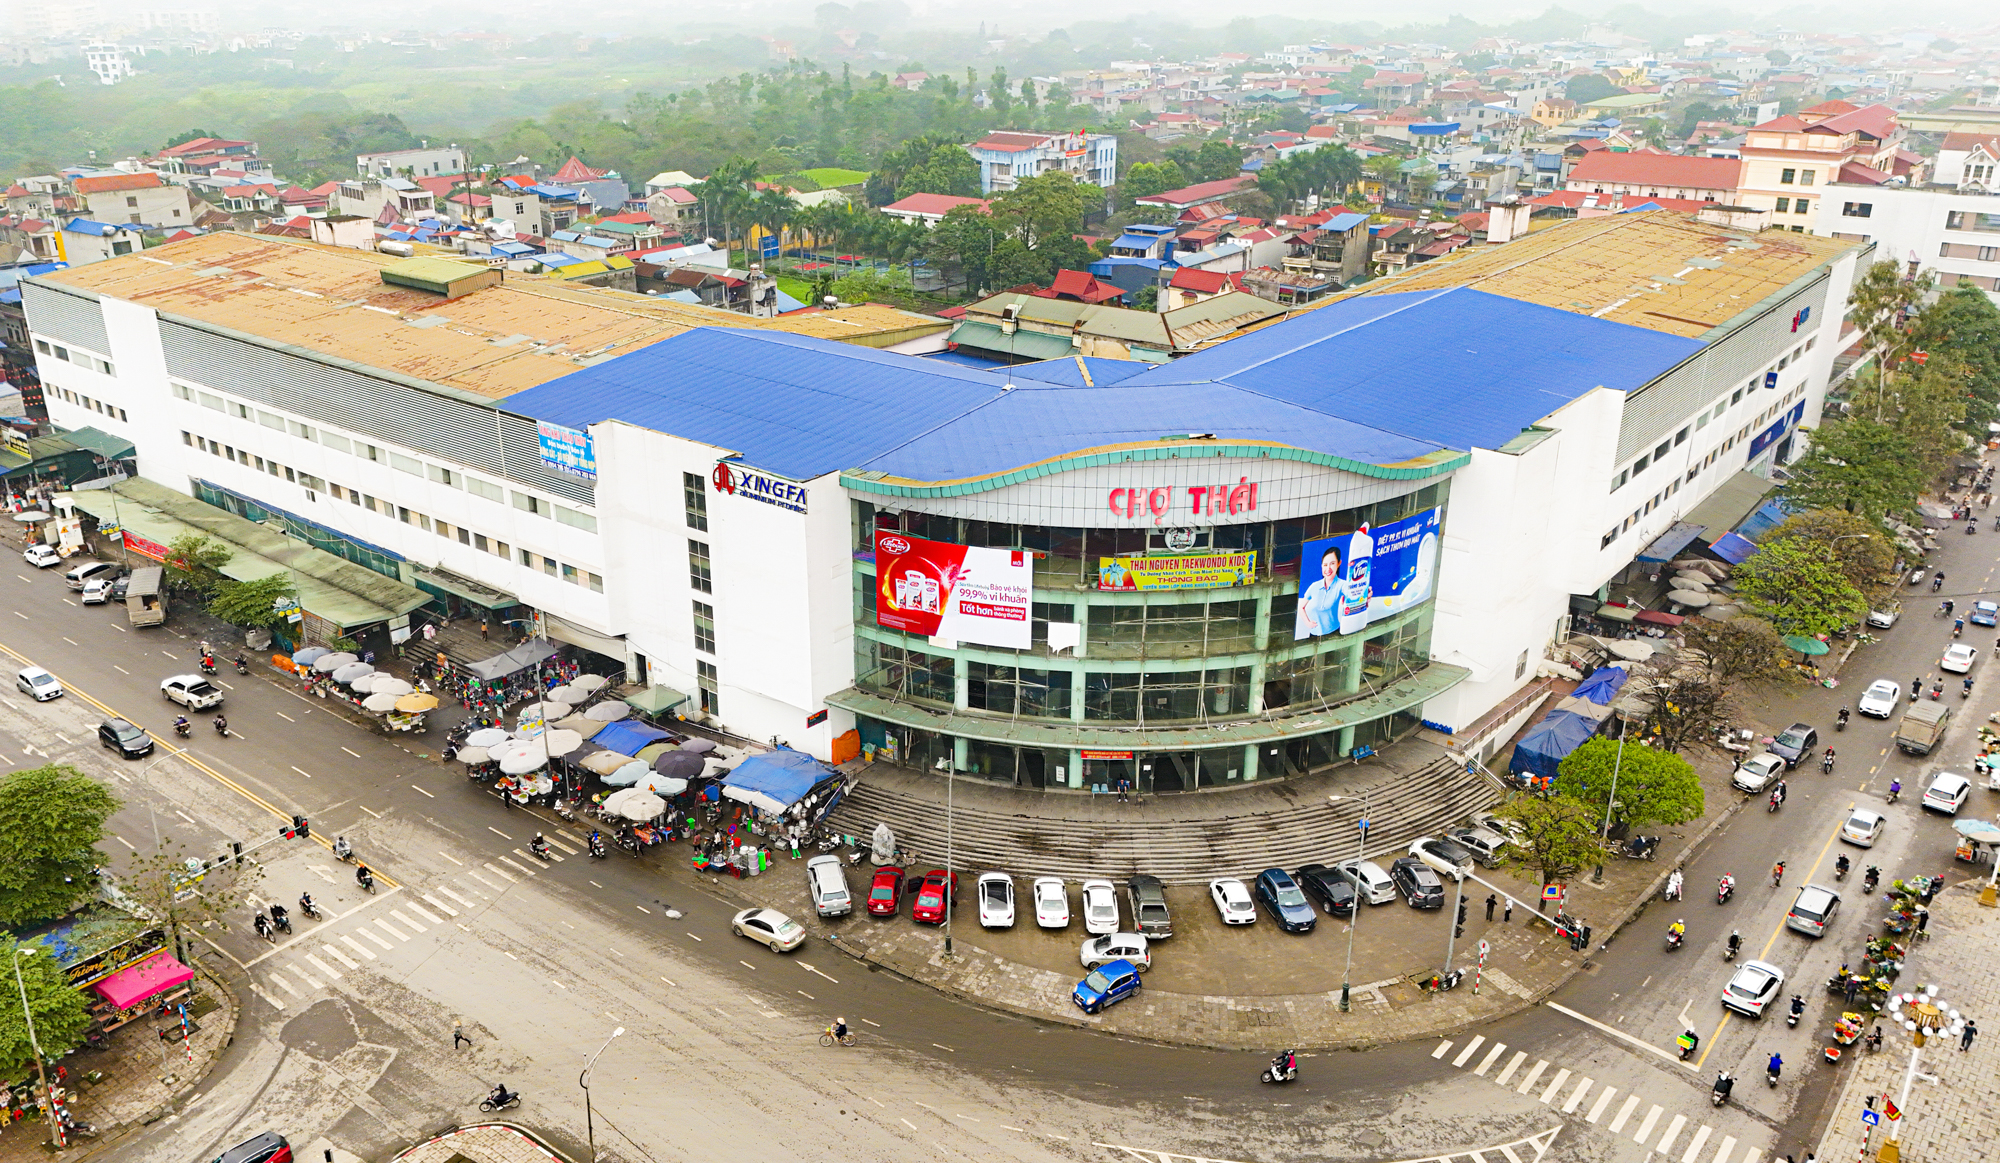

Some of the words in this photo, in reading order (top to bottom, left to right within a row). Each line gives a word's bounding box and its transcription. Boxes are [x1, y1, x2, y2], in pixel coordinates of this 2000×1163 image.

[740, 471, 806, 505] XINGFA
[1108, 485, 1173, 525] CHỢ
[1188, 476, 1259, 517] THÁI
[1130, 560, 1147, 571] THAI
[1149, 558, 1179, 571] NGUYEN
[1182, 556, 1227, 569] TAEKWONDO
[1229, 555, 1246, 567] KIDS
[1353, 565, 1368, 579] Vim
[959, 588, 988, 600] 99,9%
[989, 592, 998, 602] vi
[999, 592, 1027, 604] khuẩn
[961, 603, 976, 614] Tốt
[976, 605, 993, 616] hơn
